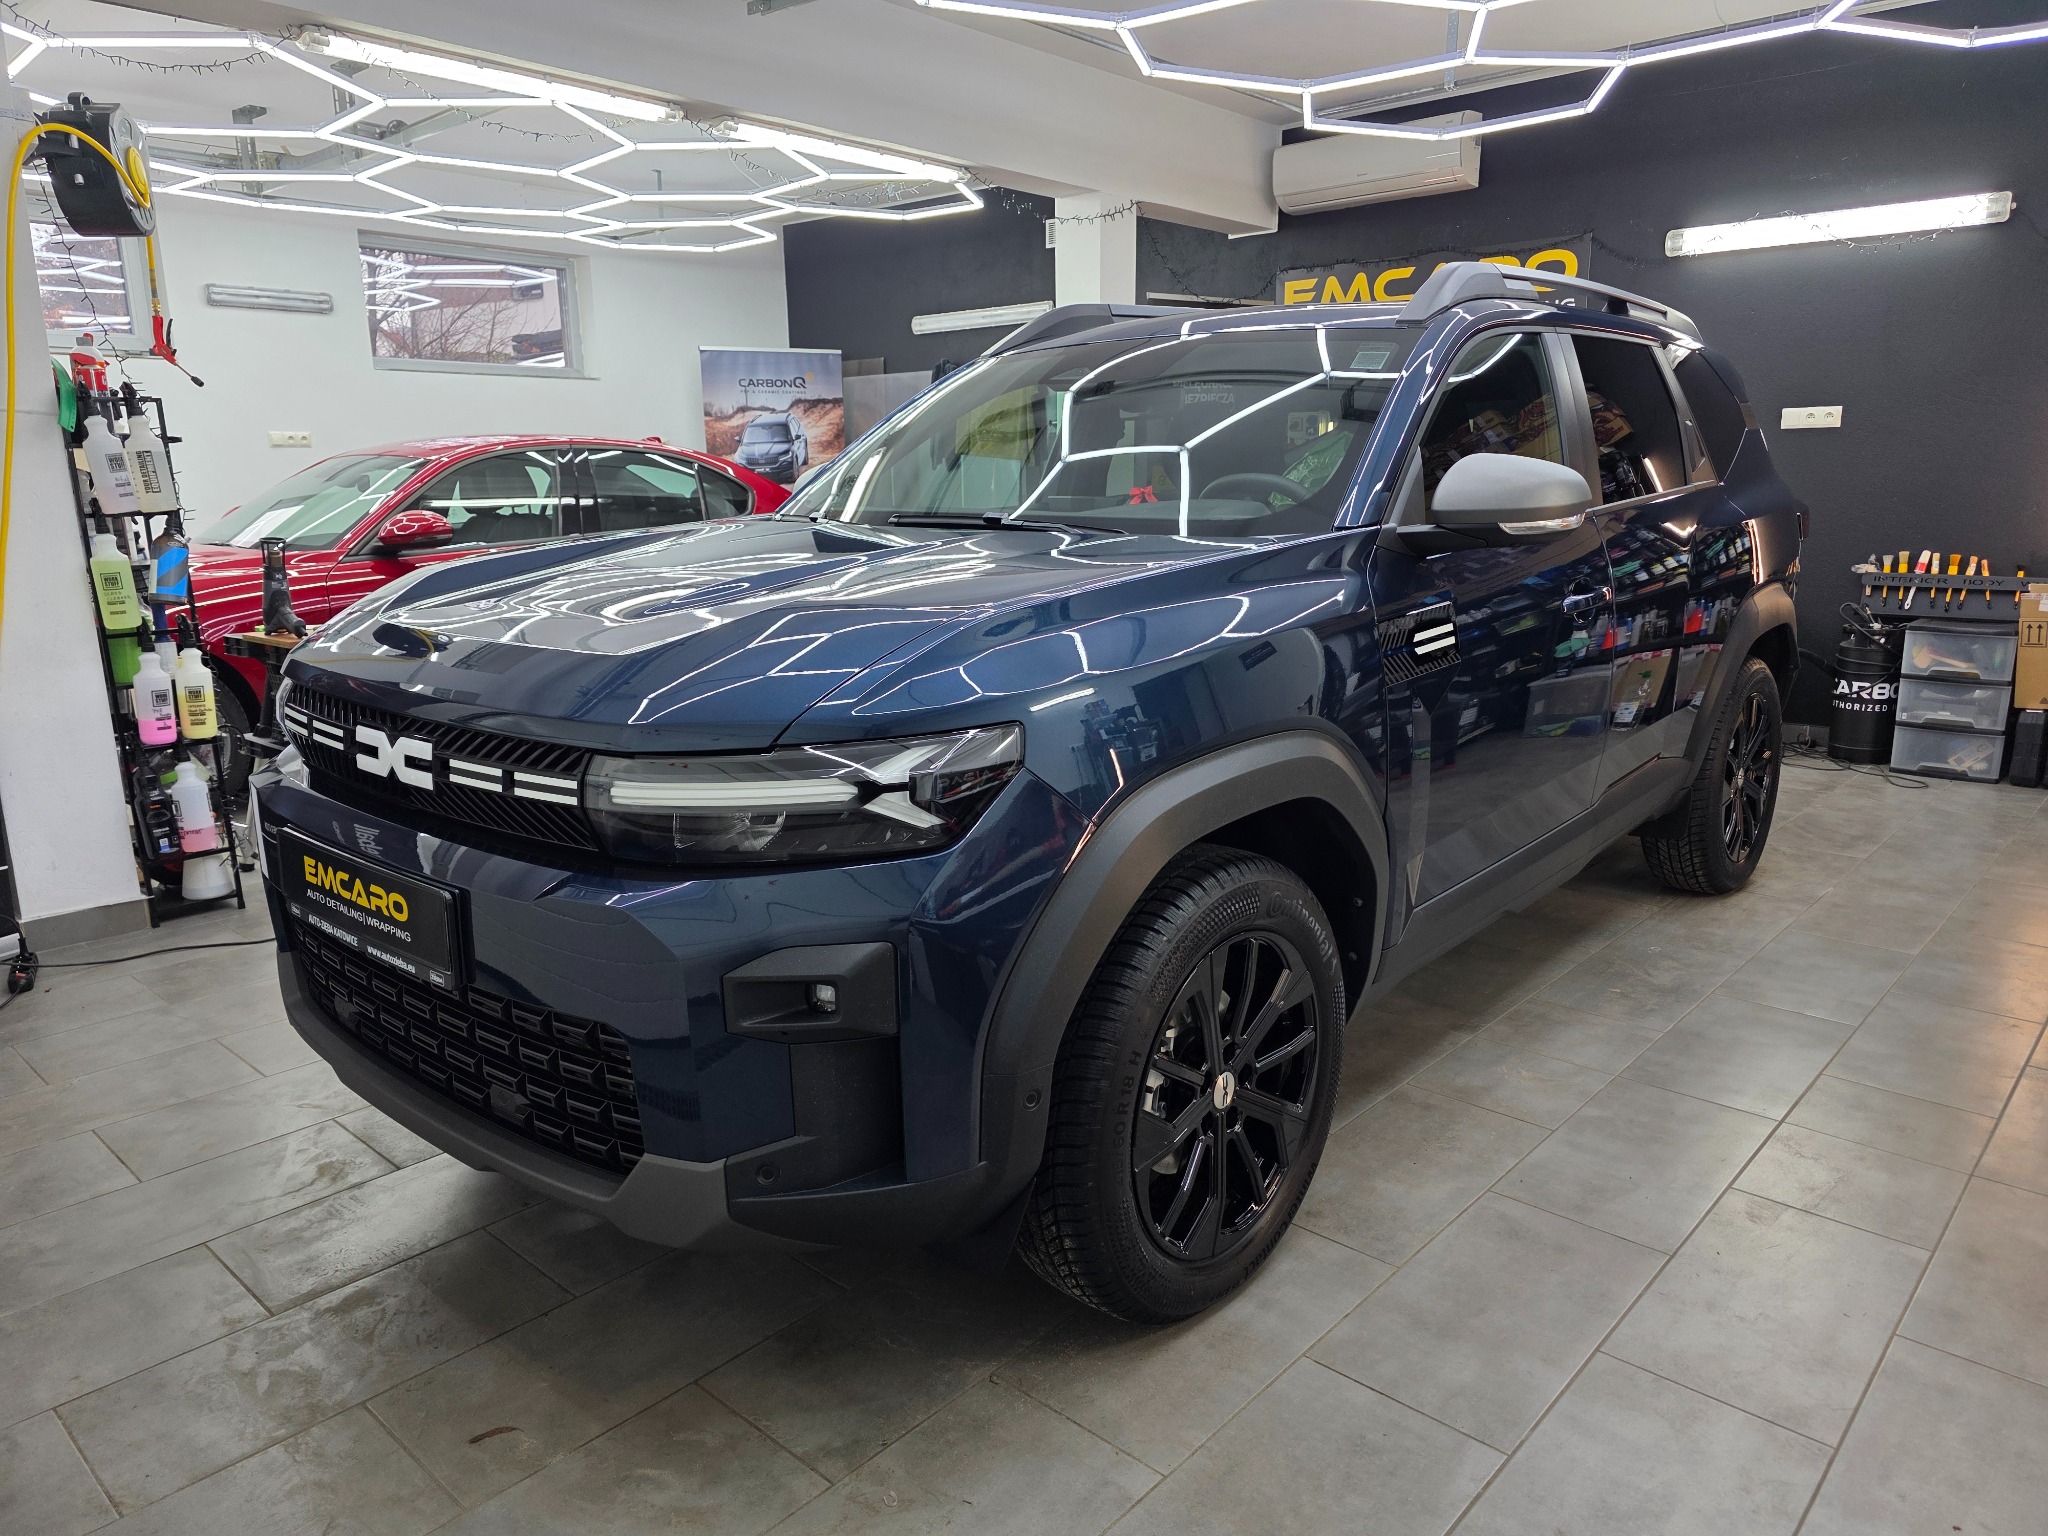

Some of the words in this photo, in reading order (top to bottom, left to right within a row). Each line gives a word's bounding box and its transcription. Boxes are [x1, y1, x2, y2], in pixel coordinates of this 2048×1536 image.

[1284, 249, 1579, 306] EMCO
[738, 376, 807, 389] CARBONQ
[136, 450, 149, 479] DETAILING
[143, 451, 160, 492] EQUIPMENT
[143, 478, 152, 494] YOUR
[1873, 575, 1948, 585] INTERIOR
[1963, 578, 2005, 587] BODY
[1832, 700, 1888, 712] THORIZED
[303, 855, 409, 922] EMCARO
[306, 889, 326, 904] AUTO
[333, 926, 358, 947] KATOWICE
